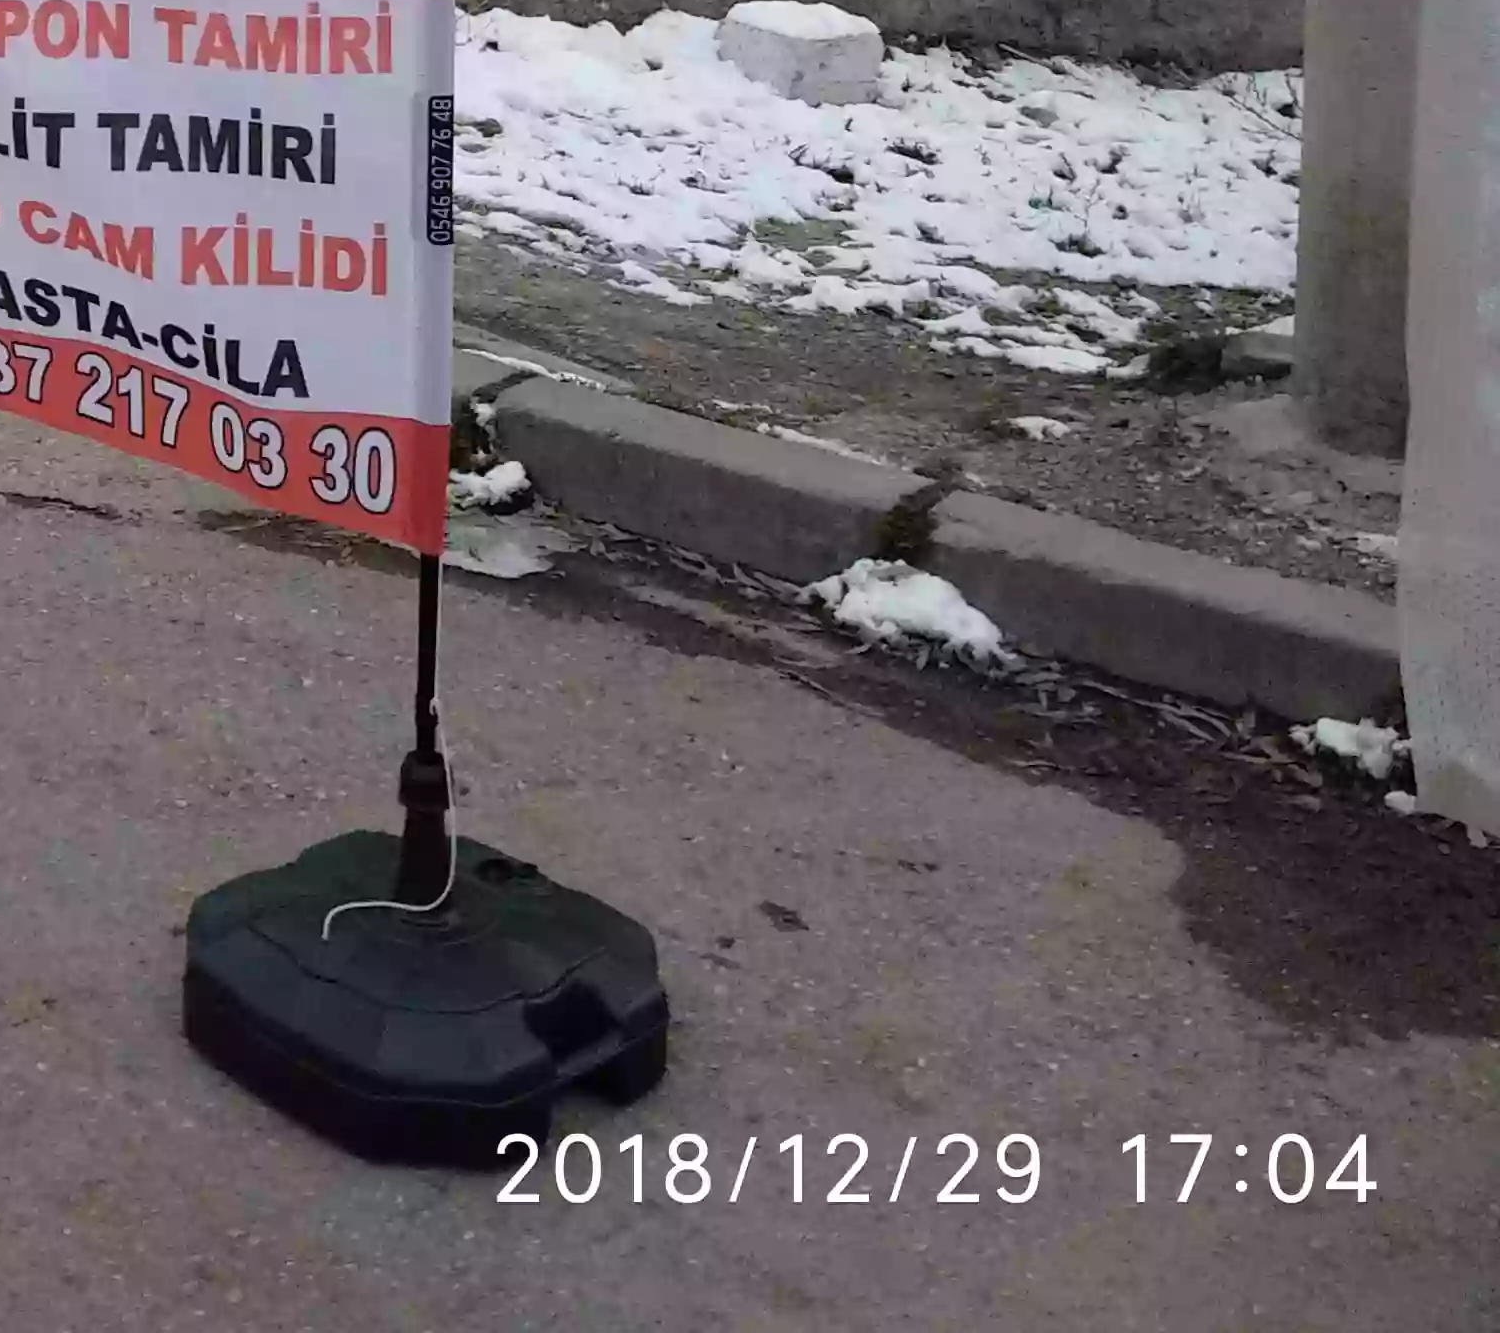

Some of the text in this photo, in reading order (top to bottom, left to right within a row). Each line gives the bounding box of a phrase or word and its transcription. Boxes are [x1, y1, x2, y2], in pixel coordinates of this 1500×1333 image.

[154, 0, 393, 75] TAMİRİ
[97, 106, 336, 185] TAMİRİ
[431, 99, 452, 242] 0546 907 76 48
[19, 199, 155, 282] CAM
[181, 212, 389, 296] KİLİDİ
[76, 353, 190, 449] 217
[211, 404, 288, 490] 03
[310, 424, 396, 515] 30
